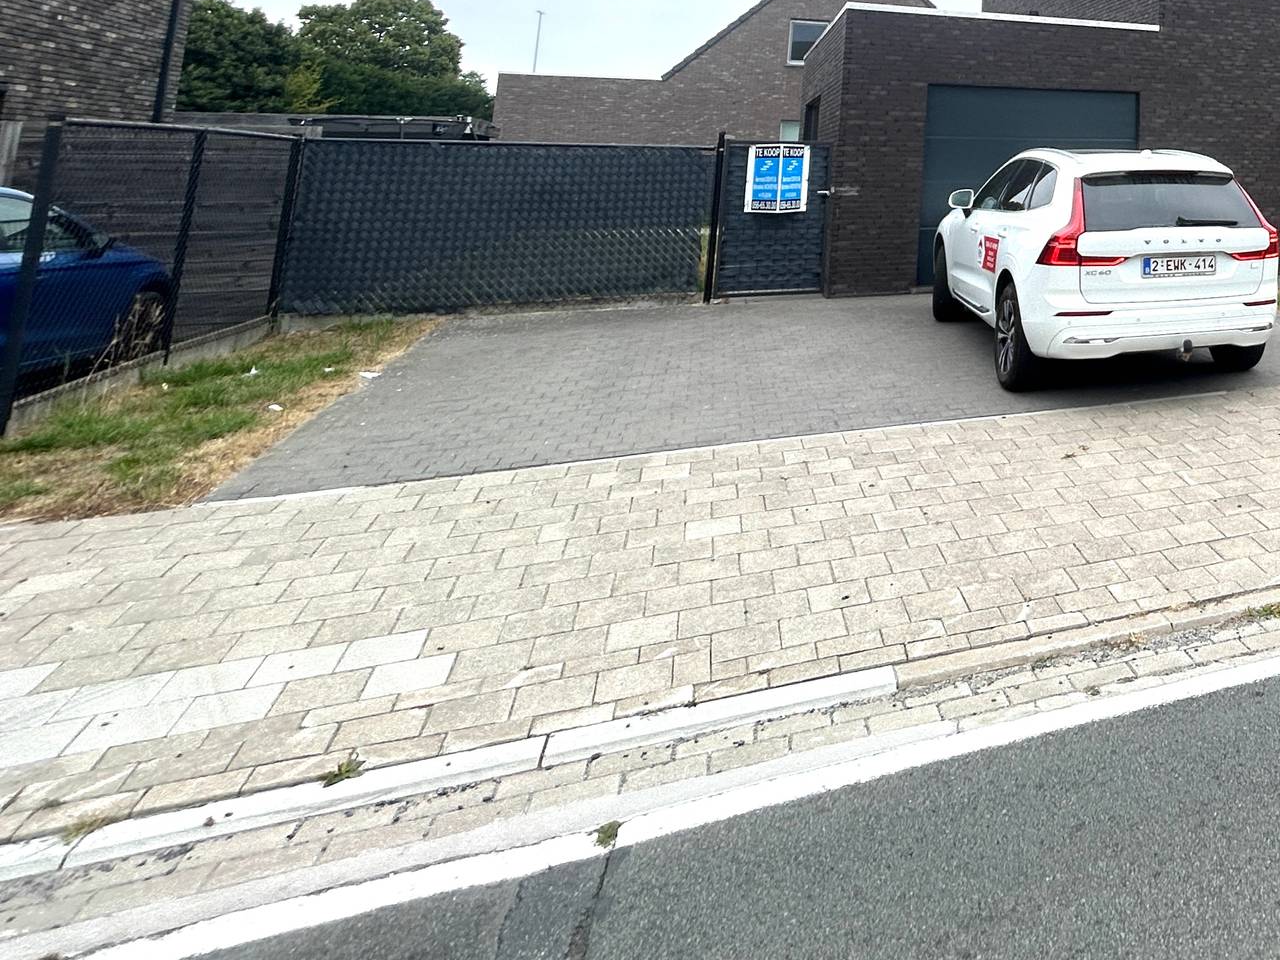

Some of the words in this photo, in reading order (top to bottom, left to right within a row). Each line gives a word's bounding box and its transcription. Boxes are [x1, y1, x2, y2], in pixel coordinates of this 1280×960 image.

[756, 148, 763, 157] TE
[764, 148, 780, 157] KOOP
[783, 148, 790, 157] TE
[790, 148, 804, 157] KOOP
